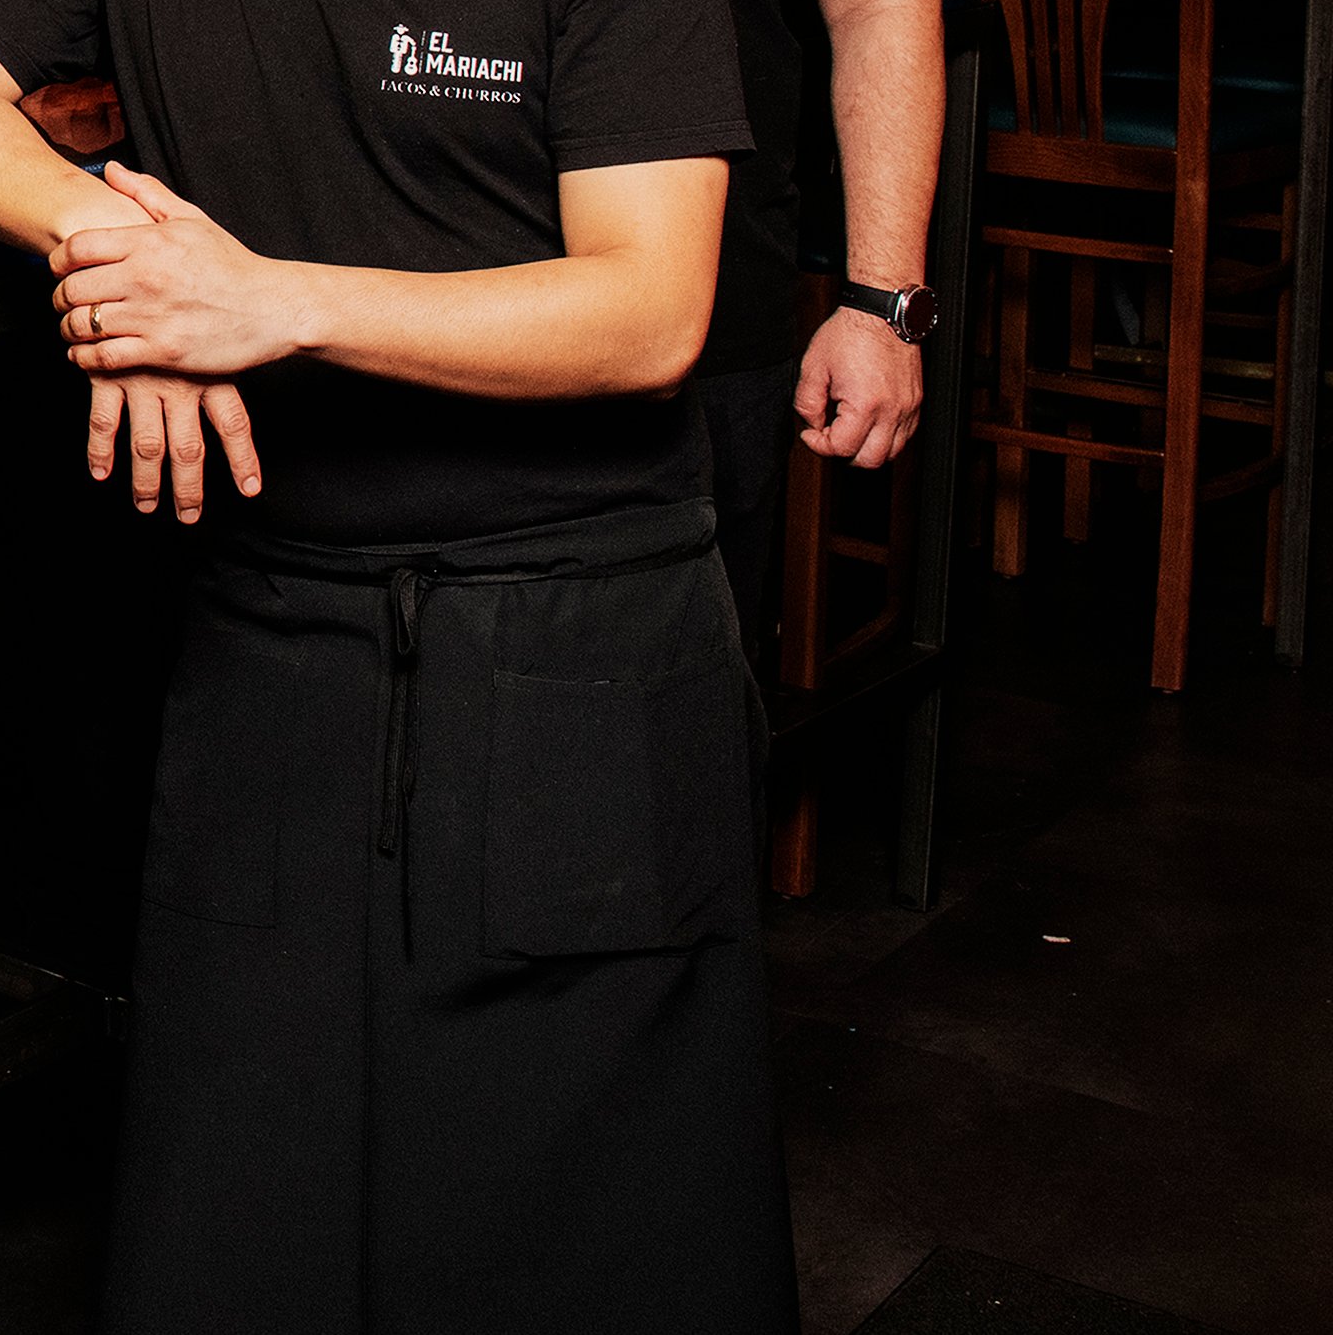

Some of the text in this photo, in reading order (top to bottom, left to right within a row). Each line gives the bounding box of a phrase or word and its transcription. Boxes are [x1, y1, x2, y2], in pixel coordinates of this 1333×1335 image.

[428, 31, 454, 53] EL
[425, 53, 524, 83] MARIACHI
[380, 79, 522, 104] TACOS & CHURROS
